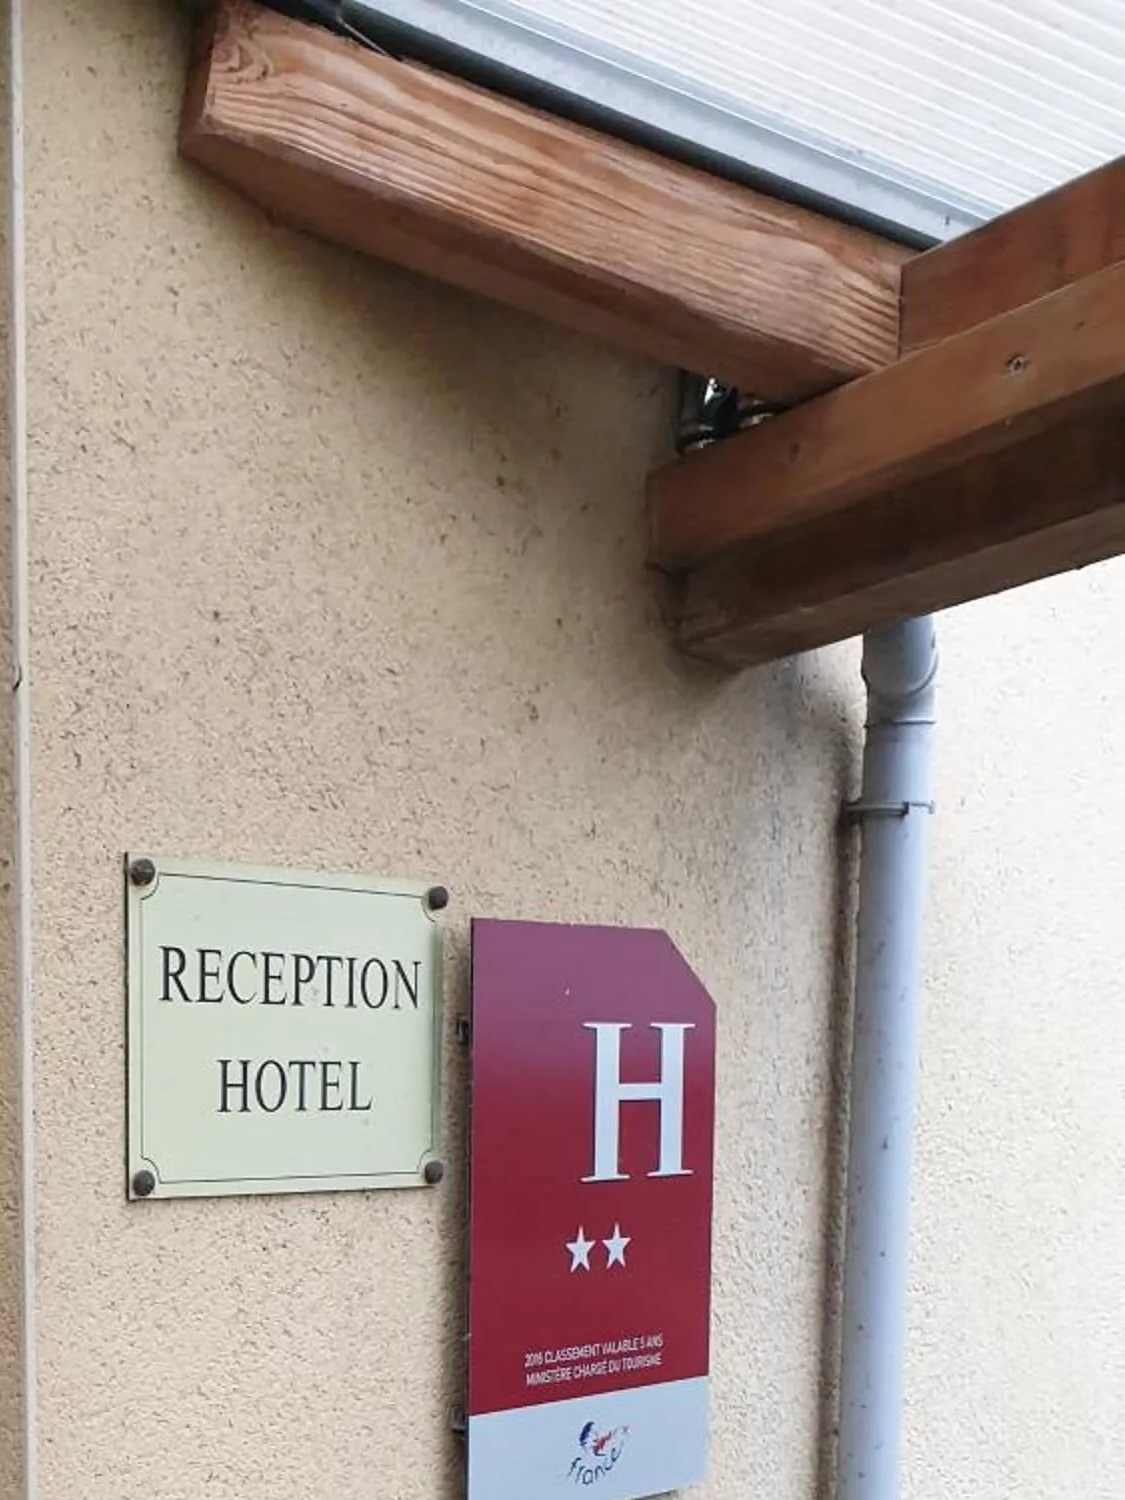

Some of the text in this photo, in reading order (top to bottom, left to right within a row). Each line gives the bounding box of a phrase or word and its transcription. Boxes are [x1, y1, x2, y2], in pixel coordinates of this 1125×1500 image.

[159, 946, 422, 1010] RECEPTION
[217, 1058, 373, 1114] HOTEL
[581, 1022, 696, 1182] H
[545, 1343, 600, 1363] CLASSEMENT
[602, 1337, 638, 1355] VALABLE
[647, 1332, 664, 1348] ANS
[609, 1359, 621, 1373] DU
[622, 1352, 663, 1370] TOURISME
